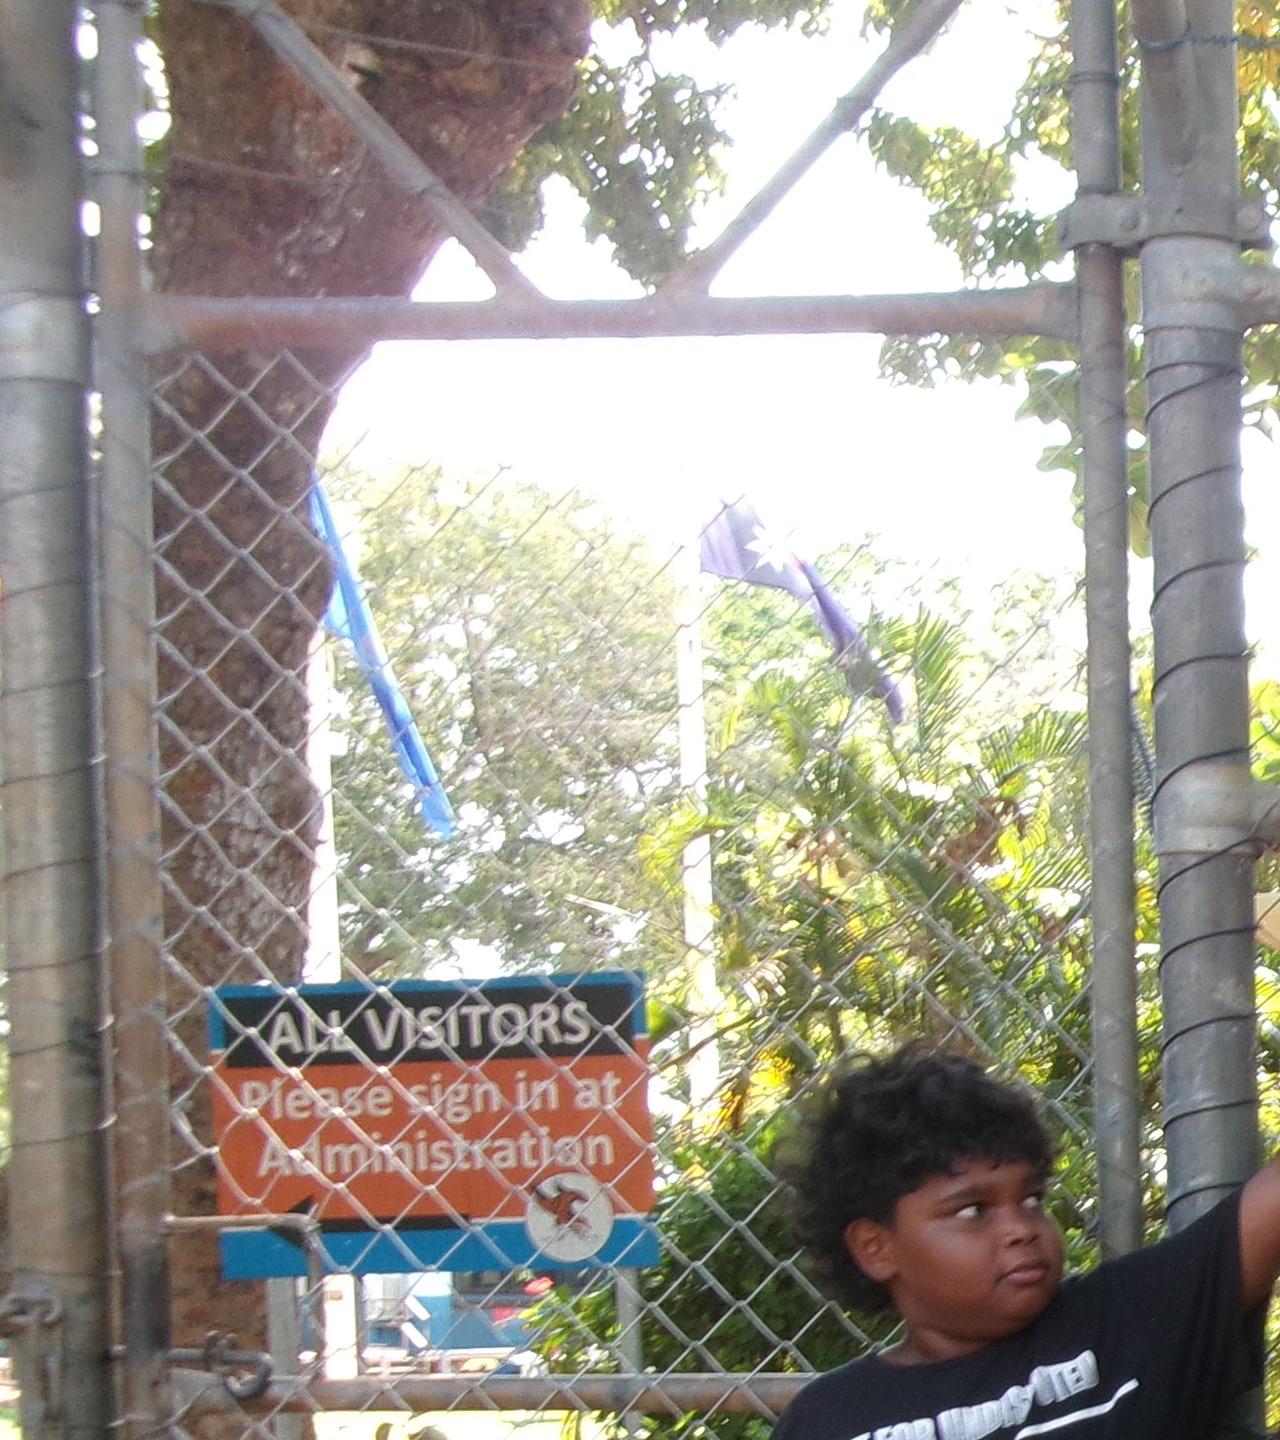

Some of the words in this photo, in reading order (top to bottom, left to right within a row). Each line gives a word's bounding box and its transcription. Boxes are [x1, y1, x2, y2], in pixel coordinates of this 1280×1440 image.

[267, 1010, 354, 1055] ALL
[364, 1000, 593, 1052] VISITORS
[239, 1078, 394, 1119] Please
[407, 1072, 502, 1123] sign
[515, 1070, 559, 1111] in
[574, 1071, 622, 1111] at
[258, 1128, 615, 1177] Administration
